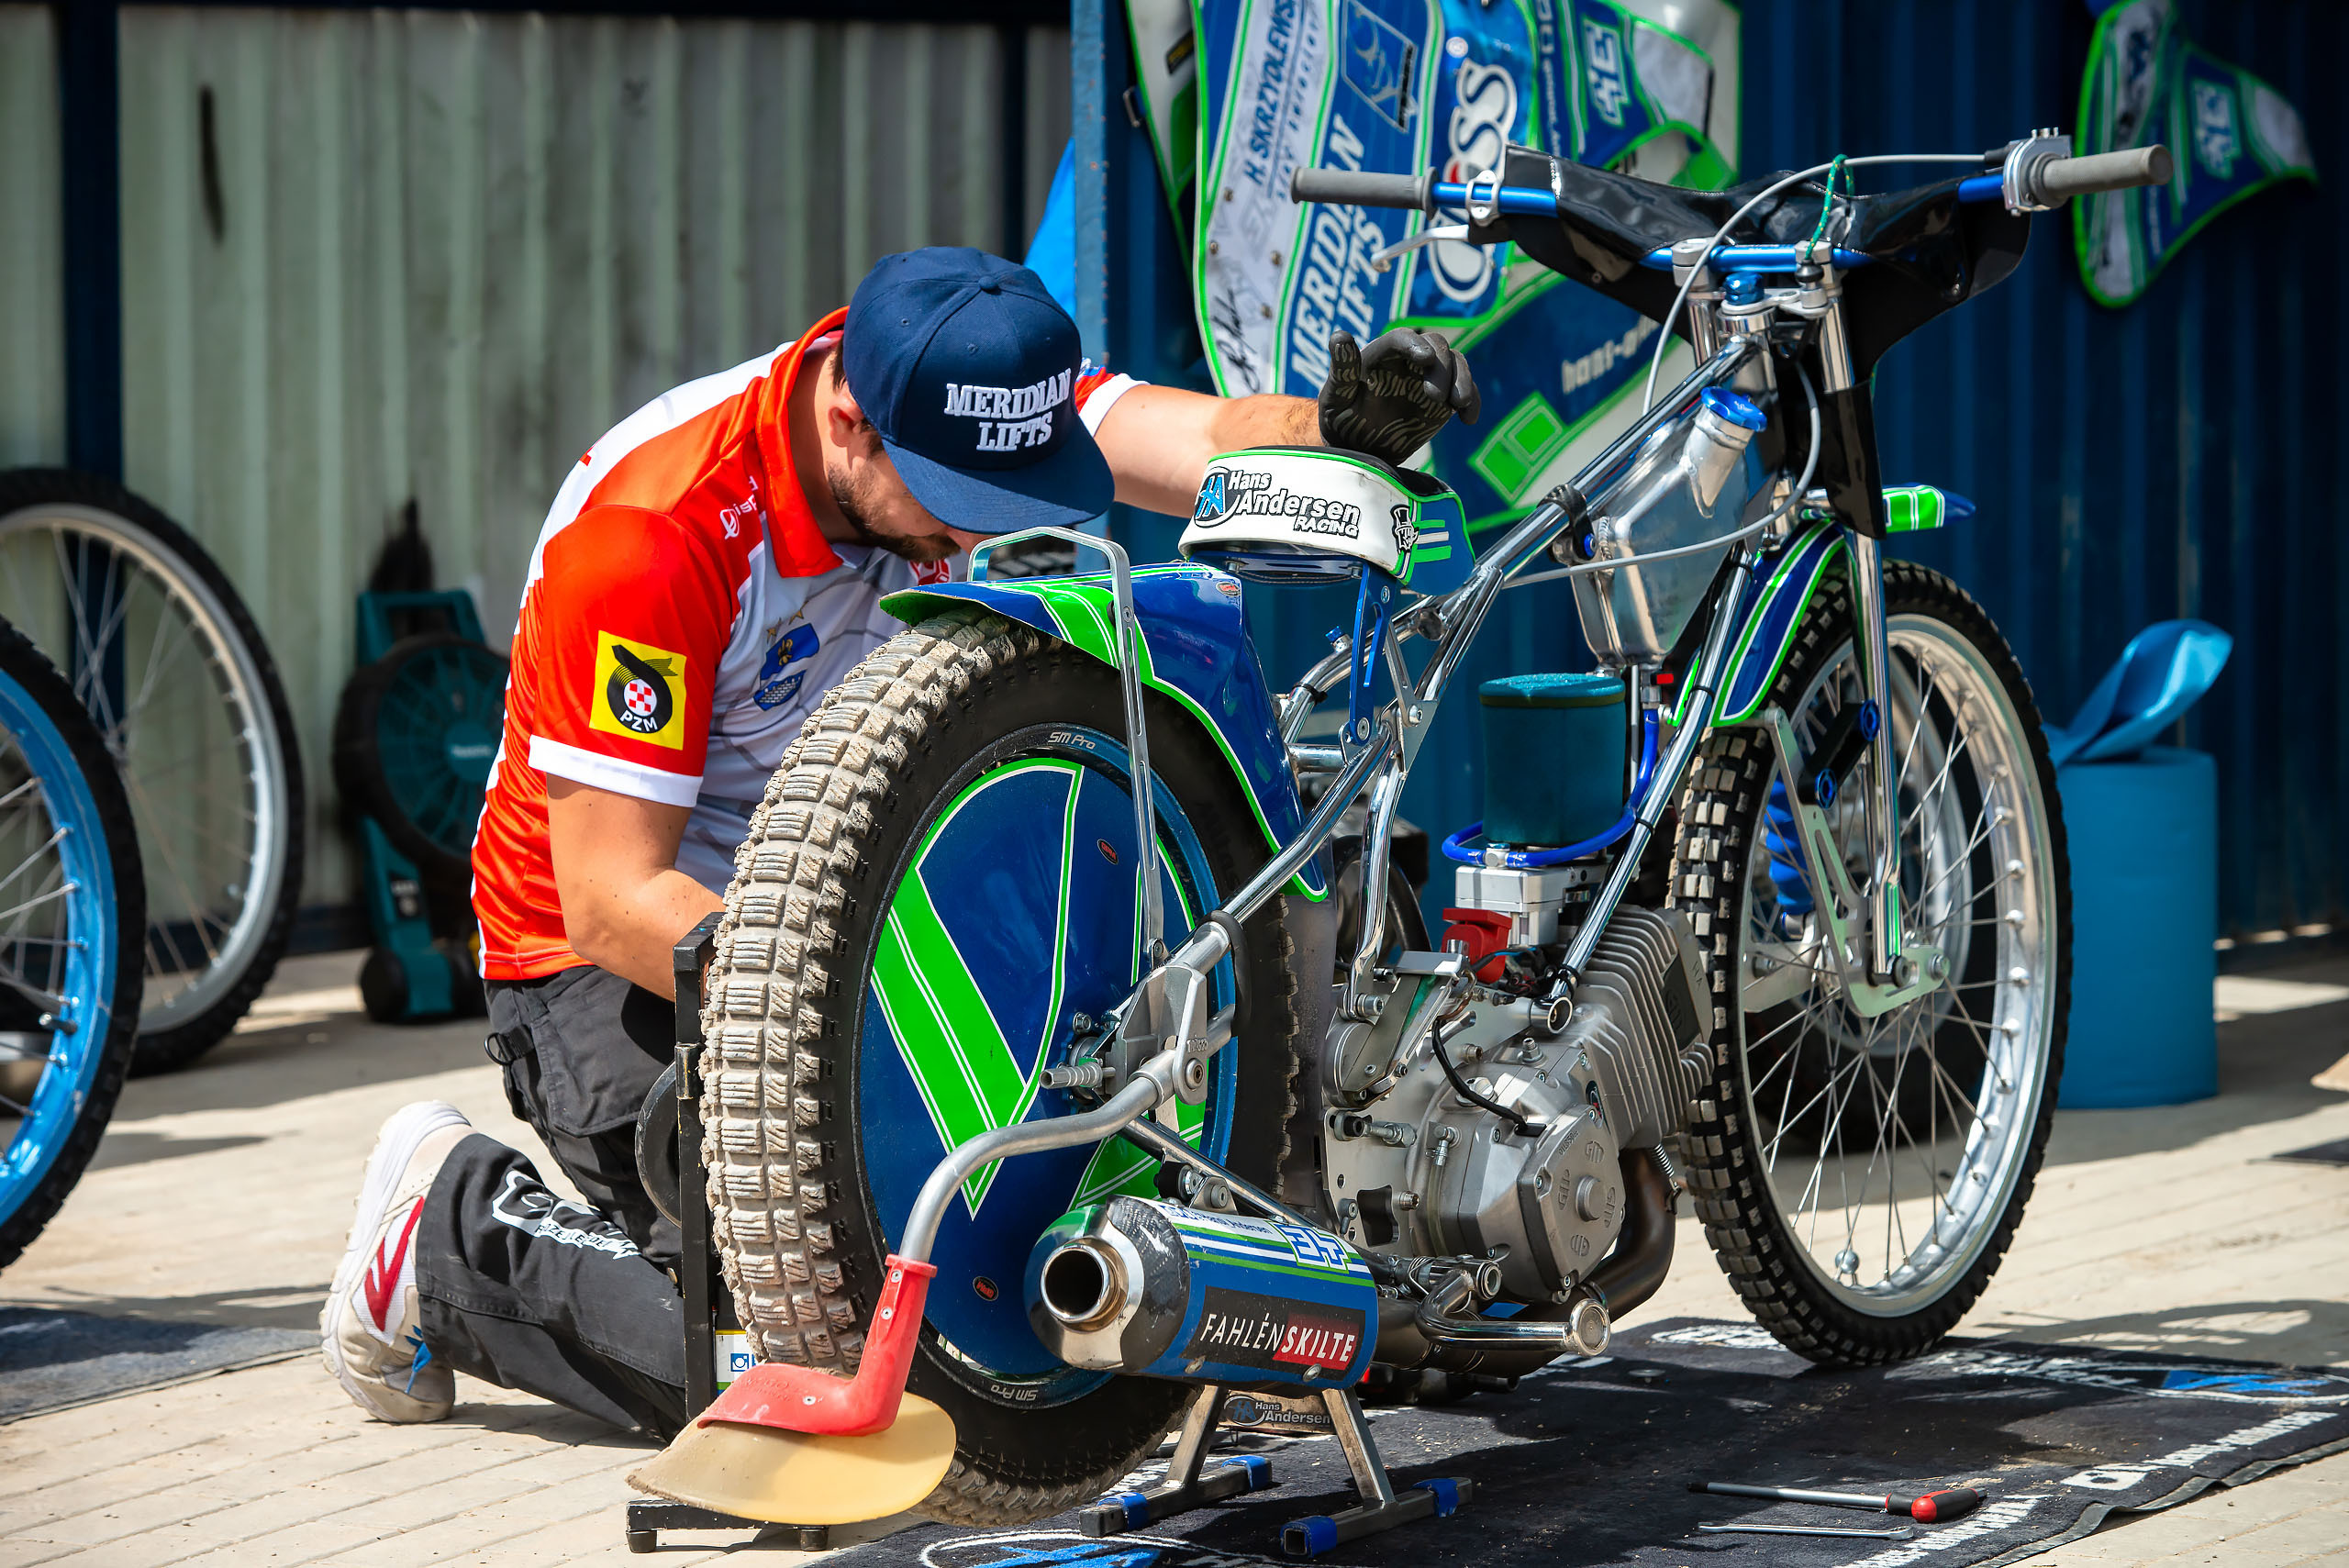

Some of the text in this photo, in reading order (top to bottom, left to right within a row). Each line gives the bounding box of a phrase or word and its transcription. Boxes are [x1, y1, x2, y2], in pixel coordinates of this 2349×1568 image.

[1250, 0, 1296, 160] SKRZYDLEWS
[1291, 113, 1365, 393] MERIDIN
[944, 368, 1071, 419] MERIDIAN
[976, 411, 1052, 451] LIFTS
[1228, 470, 1271, 491] Hans
[1235, 489, 1361, 526] Andersen
[1293, 516, 1360, 539] RACING
[619, 709, 658, 732] PZM
[1048, 731, 1097, 751] SM Pro
[990, 1384, 1015, 1399] Pro
[1255, 1401, 1281, 1411] Hans
[1264, 1410, 1330, 1424] Andersen
